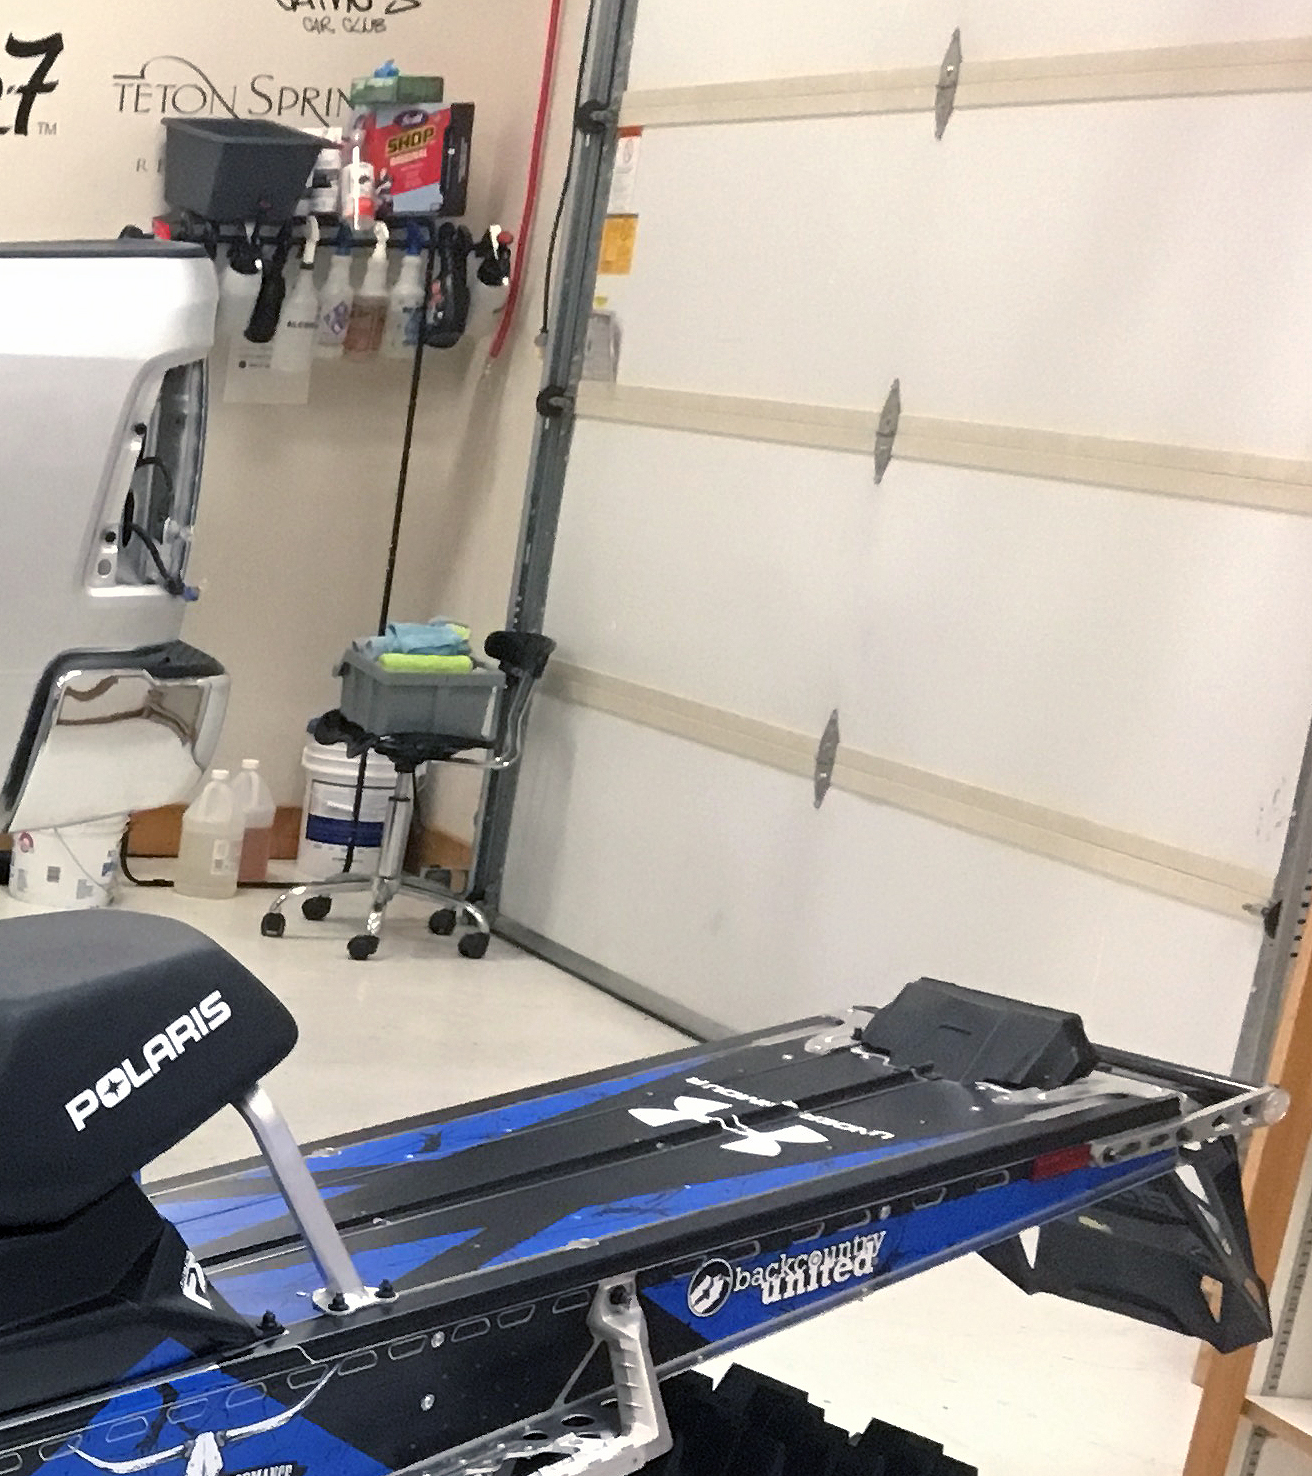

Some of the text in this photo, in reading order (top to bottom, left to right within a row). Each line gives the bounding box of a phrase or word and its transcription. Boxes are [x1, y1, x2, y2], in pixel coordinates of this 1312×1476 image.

[342, 17, 387, 33] CLUB
[113, 80, 239, 119] TETON
[387, 126, 435, 153] SHOP
[65, 990, 233, 1132] POLARIS
[734, 1231, 887, 1292] backcountry
[761, 1238, 874, 1304] united
